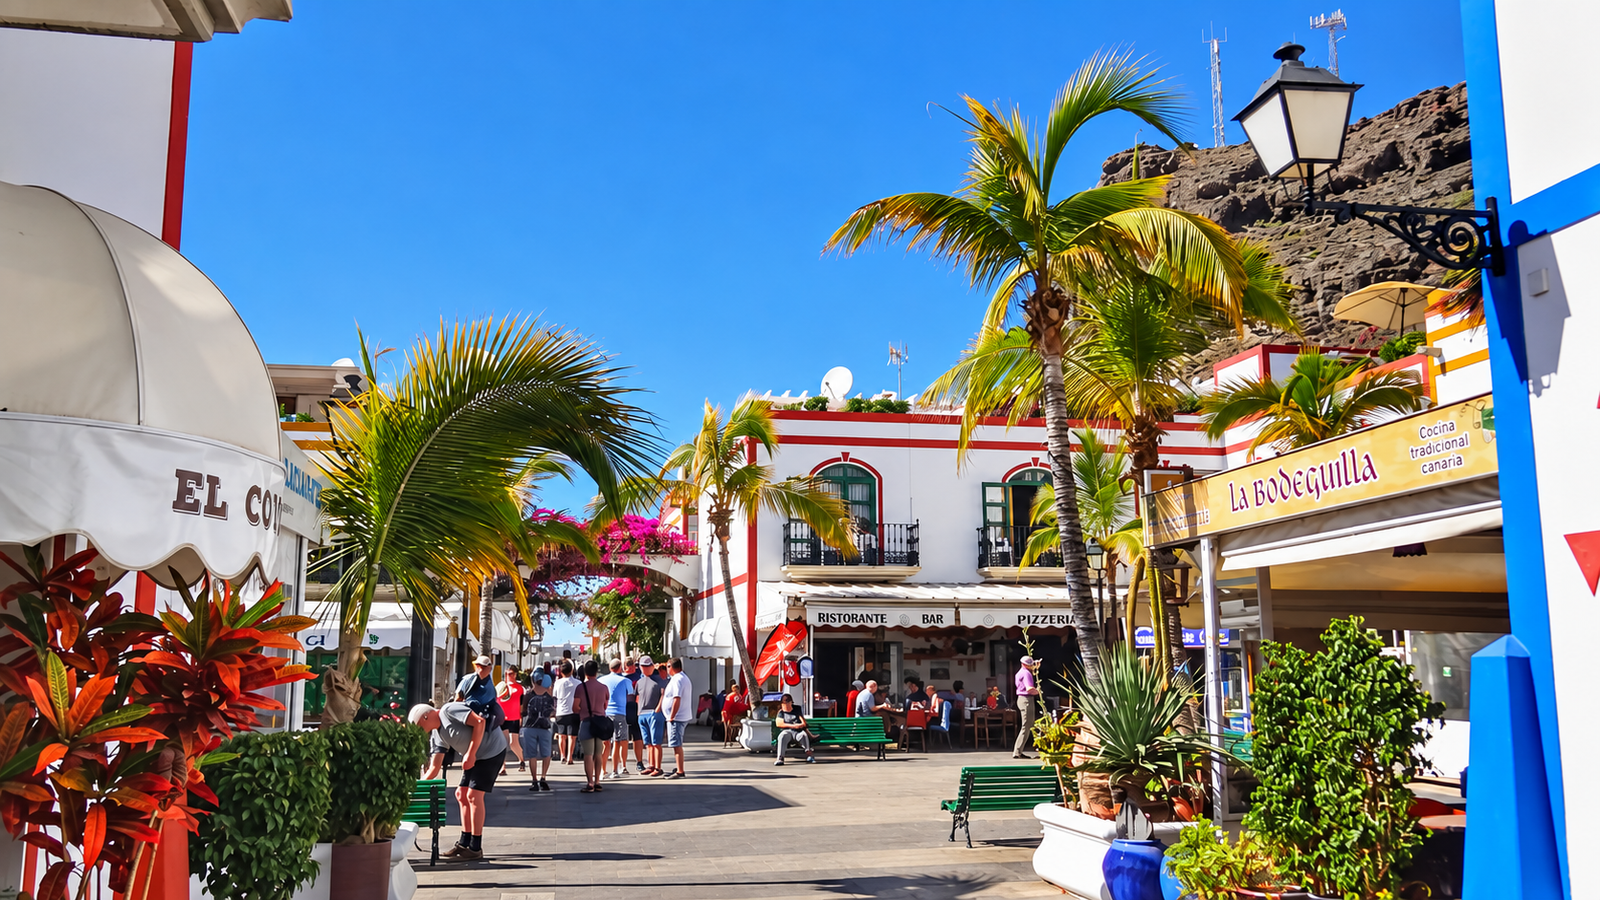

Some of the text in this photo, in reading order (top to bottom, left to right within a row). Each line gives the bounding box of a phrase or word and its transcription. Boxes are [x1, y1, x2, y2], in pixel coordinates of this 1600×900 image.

[1420, 421, 1455, 439] Cocina
[1410, 433, 1469, 459] tradicional
[1421, 454, 1463, 474] canaria
[172, 468, 228, 521] EL
[818, 612, 943, 625] RISTORANTE BAR
